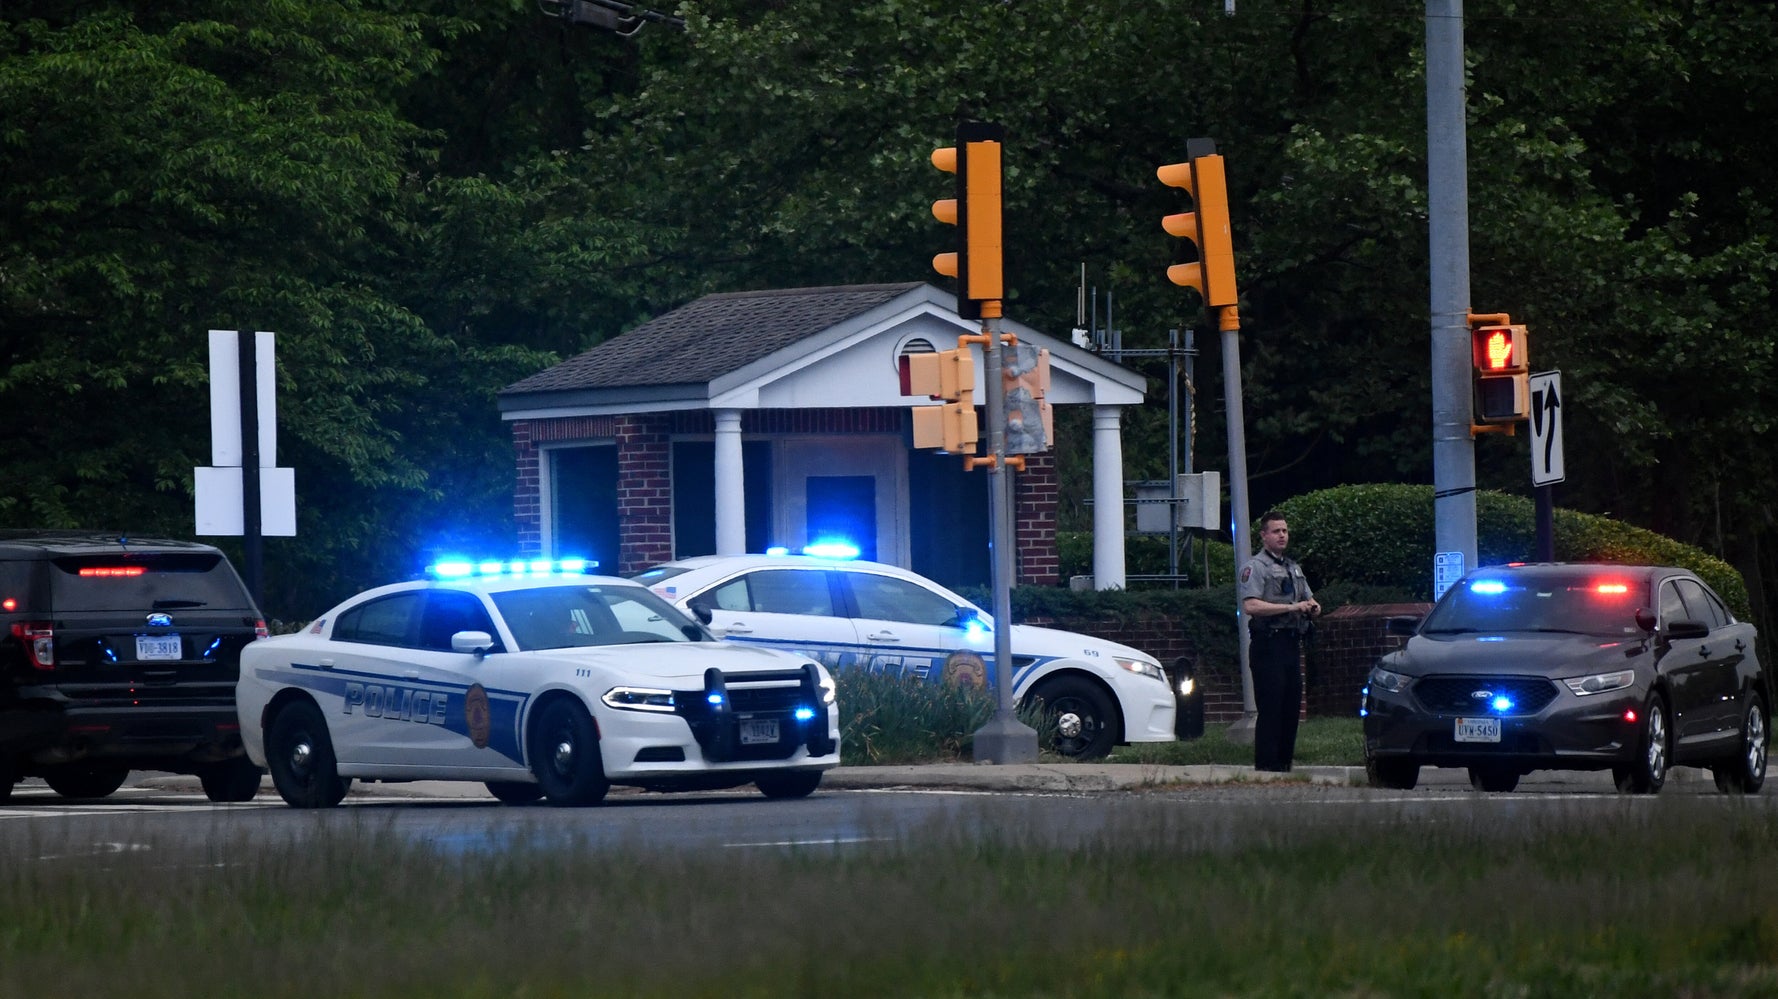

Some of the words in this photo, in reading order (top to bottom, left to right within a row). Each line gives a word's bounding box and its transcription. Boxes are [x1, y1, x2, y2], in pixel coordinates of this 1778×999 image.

[1083, 649, 1099, 657] 69
[576, 668, 591, 677] 111
[343, 682, 448, 725] POLICE
